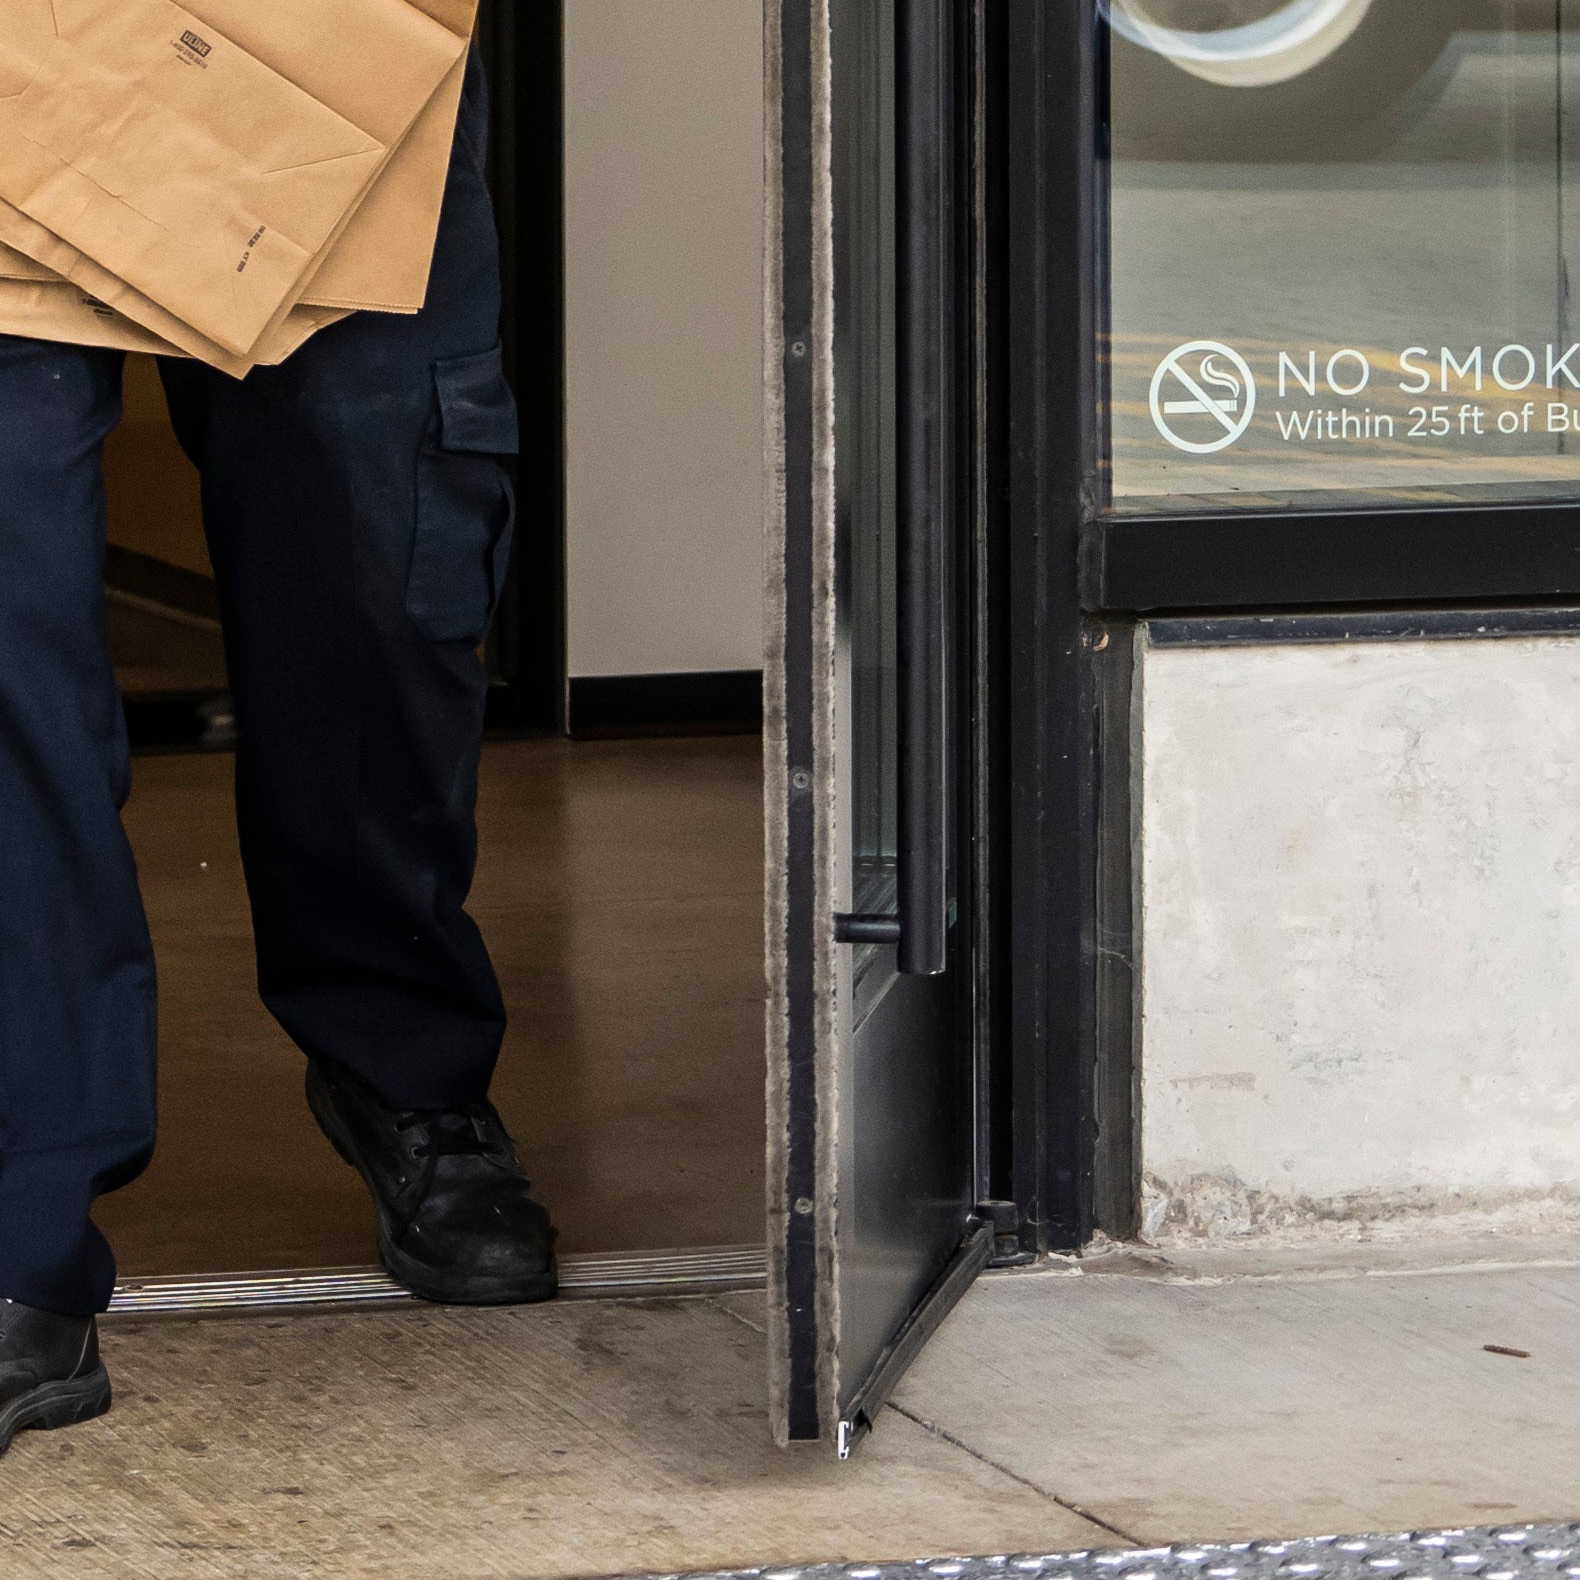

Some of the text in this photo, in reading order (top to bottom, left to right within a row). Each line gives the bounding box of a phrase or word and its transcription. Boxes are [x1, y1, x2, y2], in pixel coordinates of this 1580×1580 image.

[180, 30, 211, 57] ULINE
[1278, 343, 1580, 397] NO SMOK
[1276, 408, 1394, 440] Within
[1497, 402, 1535, 434] of
